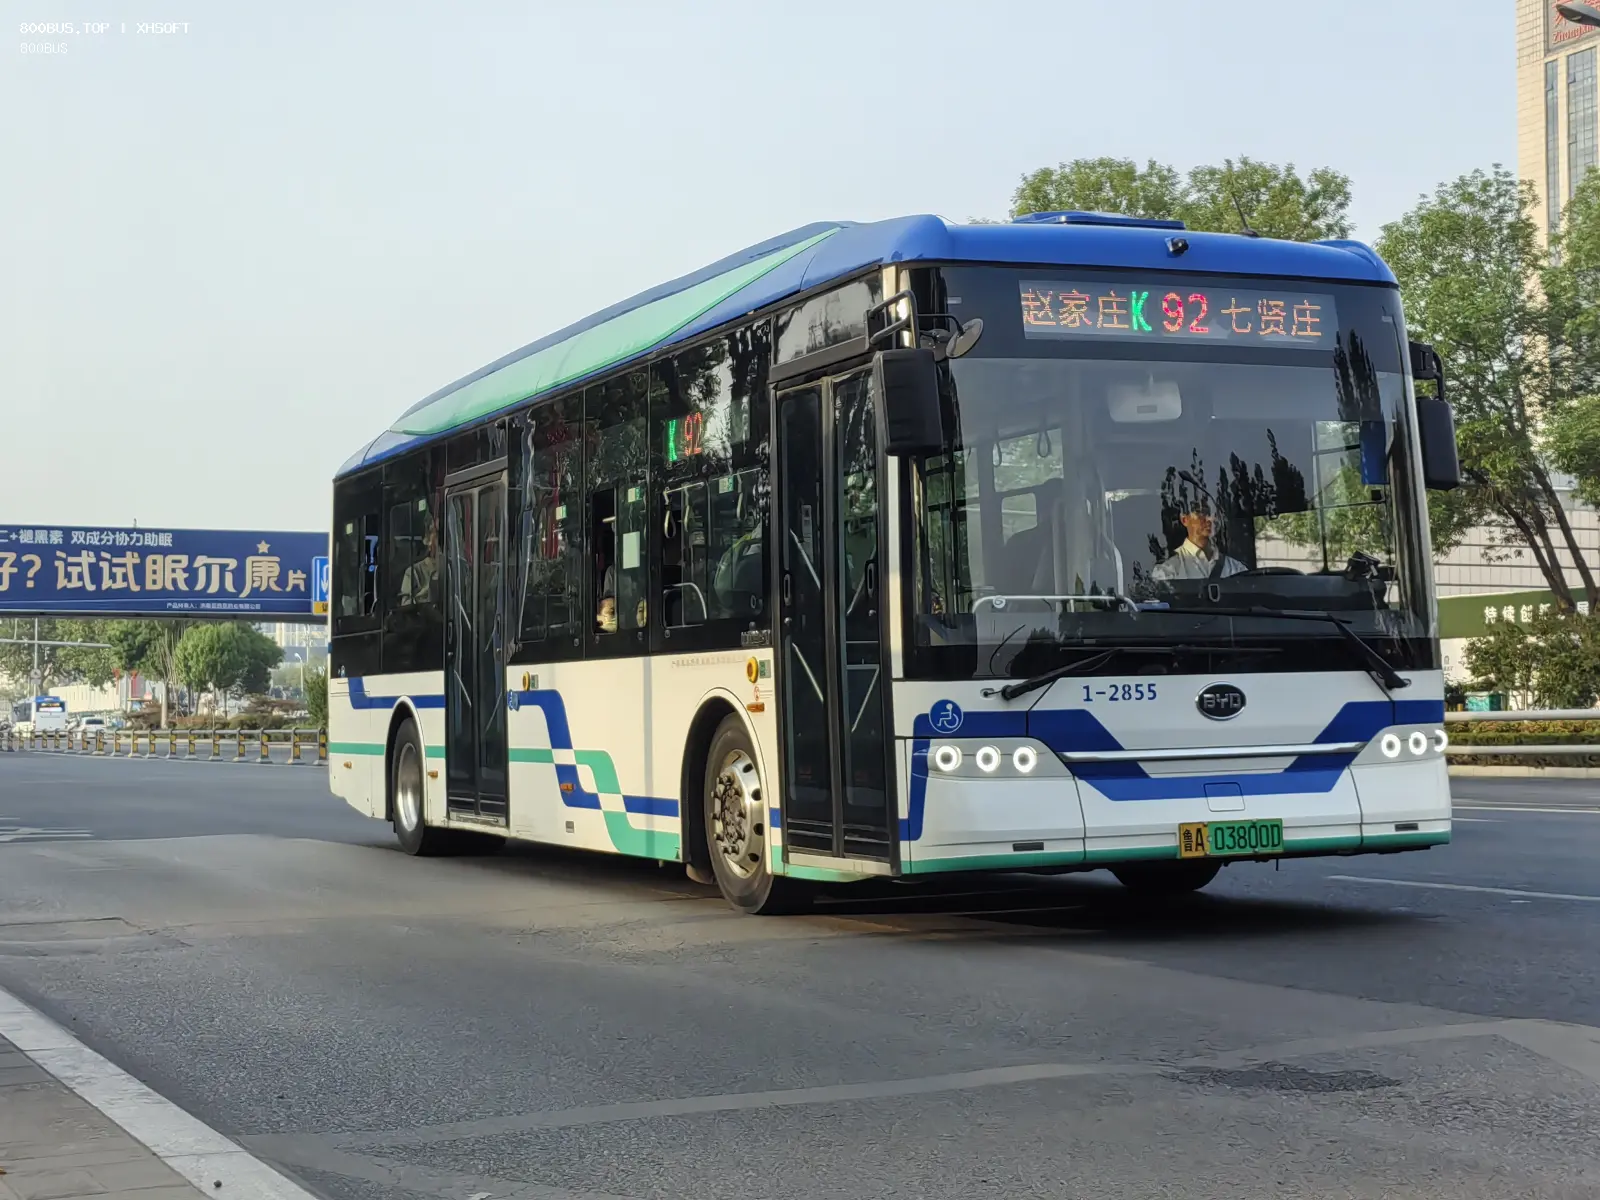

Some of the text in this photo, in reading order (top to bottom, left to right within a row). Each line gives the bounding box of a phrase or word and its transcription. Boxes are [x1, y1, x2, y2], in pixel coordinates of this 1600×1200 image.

[1021, 288, 1129, 329] 赵家庄
[1221, 297, 1322, 336] 七贤庄
[70, 530, 173, 547] 双成分协力助眠
[1082, 683, 1157, 702] 1-2855
[1203, 692, 1242, 708] BYD
